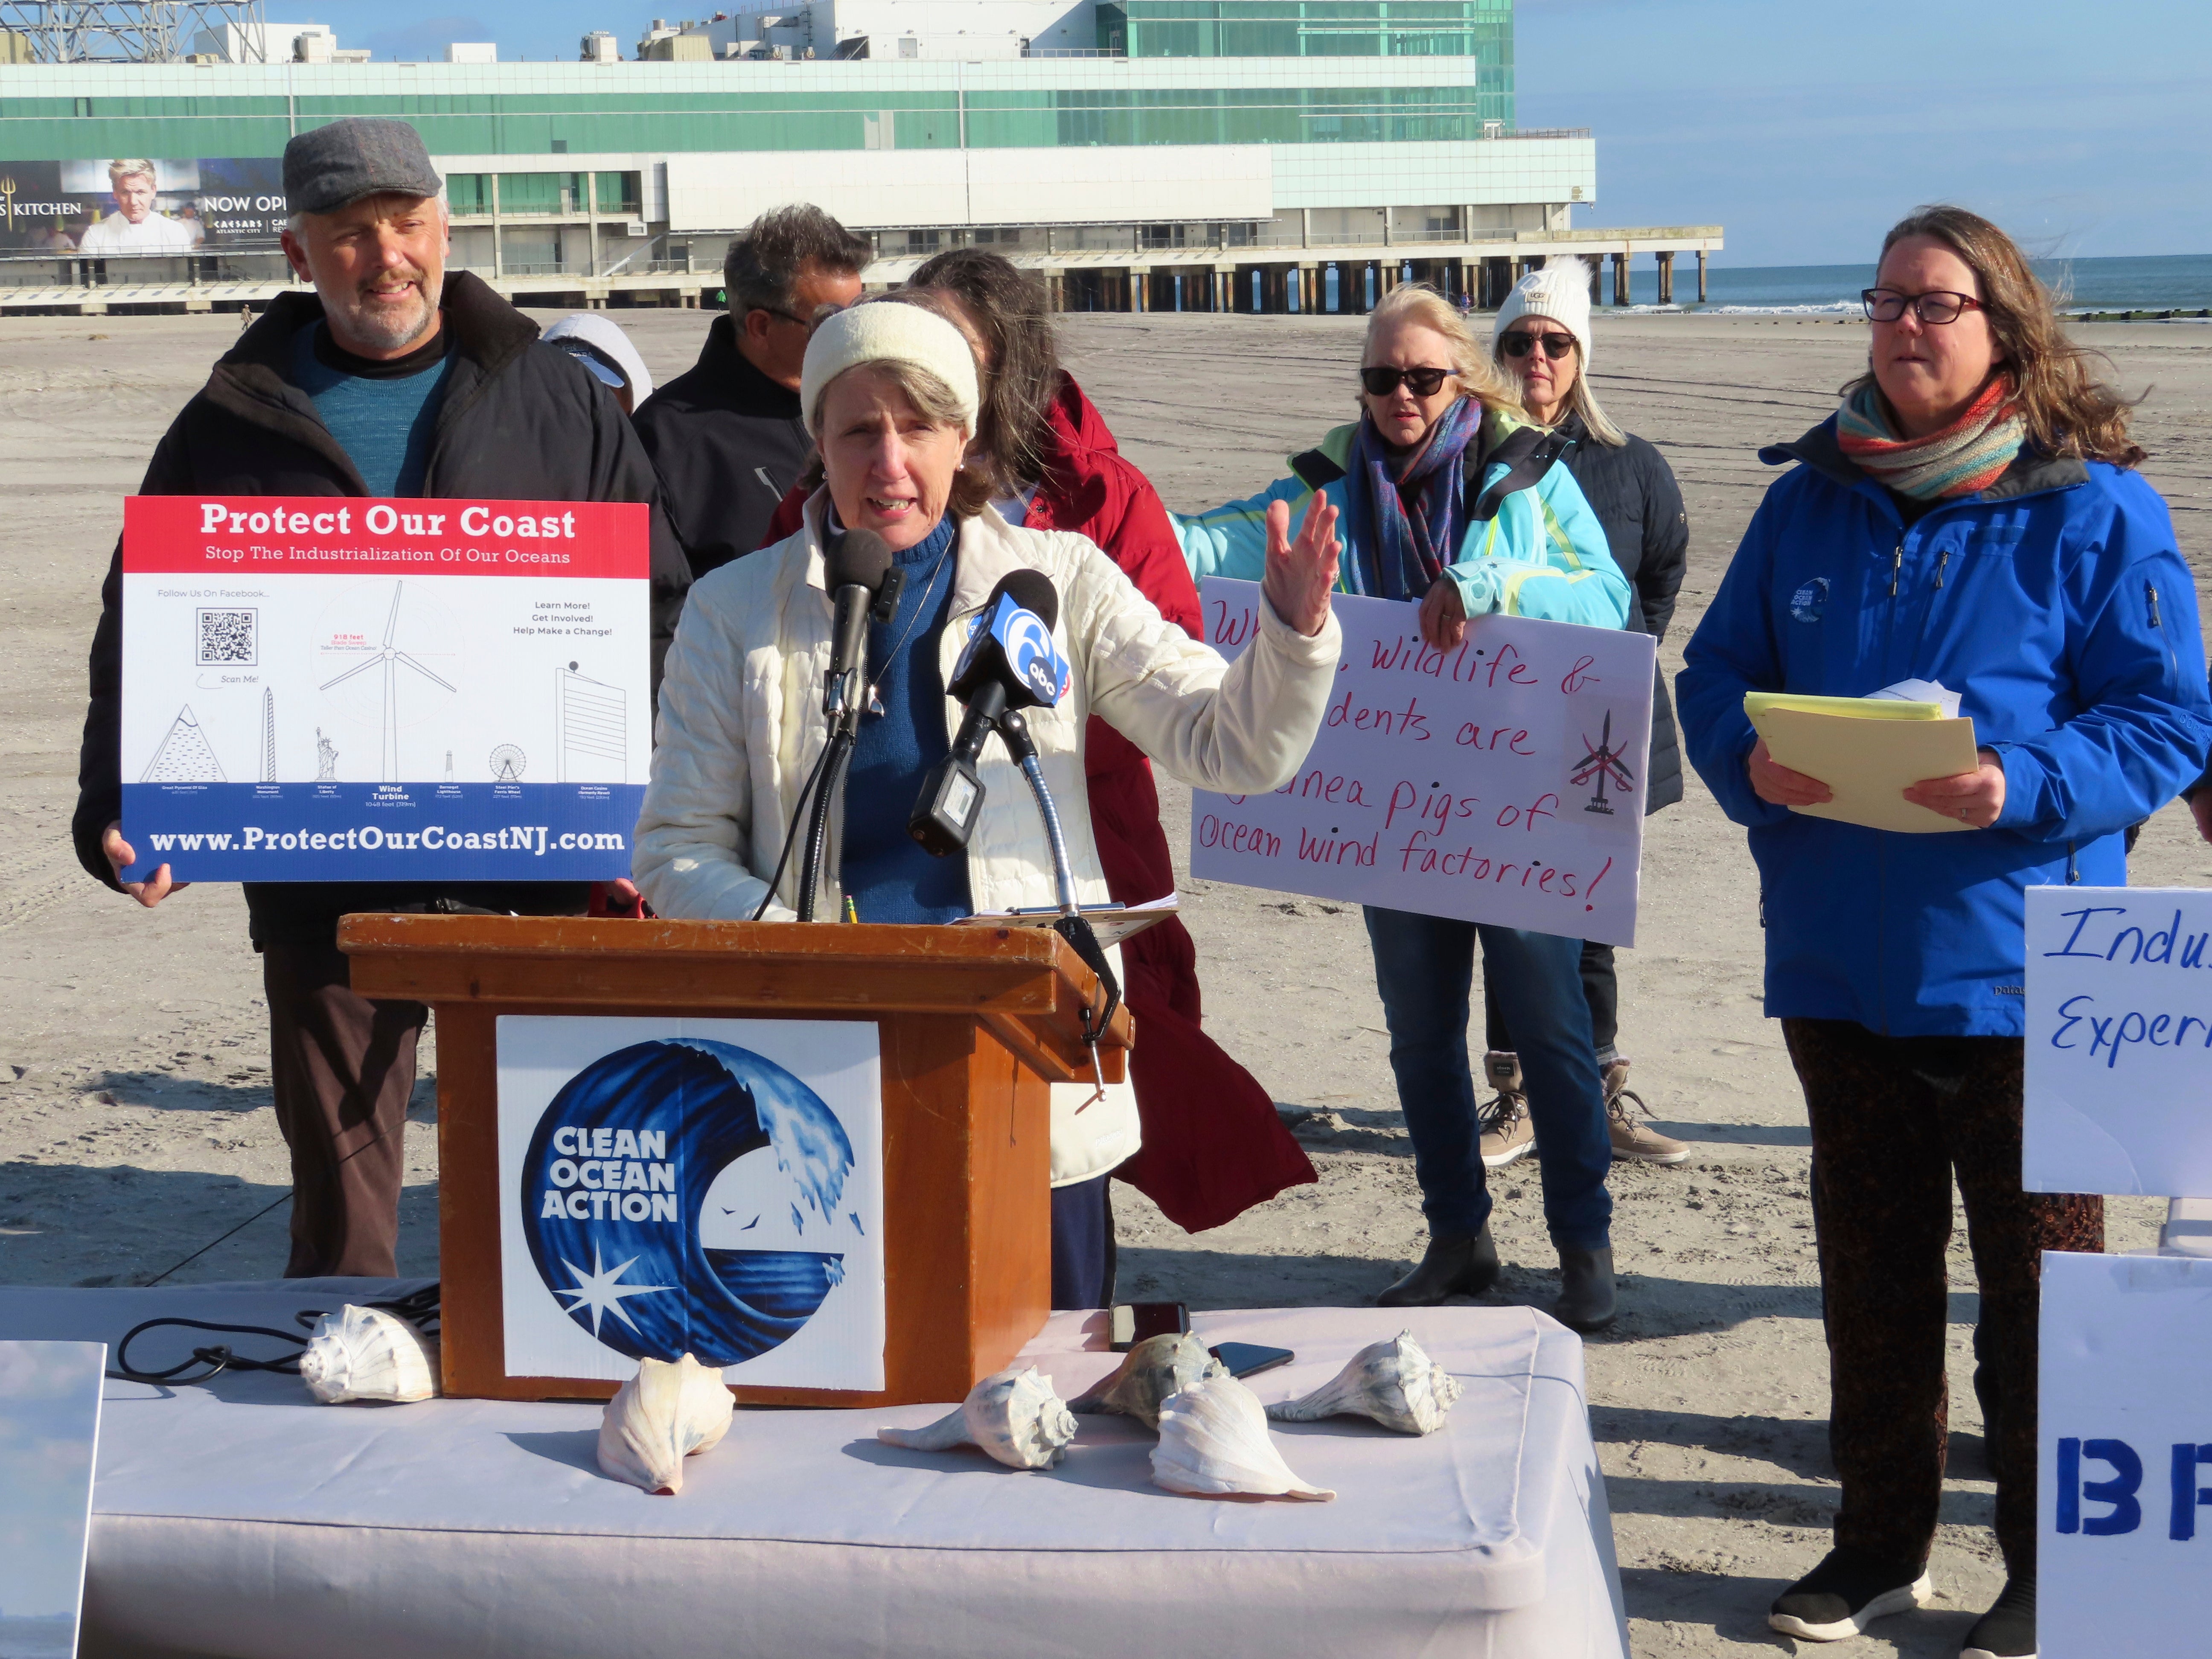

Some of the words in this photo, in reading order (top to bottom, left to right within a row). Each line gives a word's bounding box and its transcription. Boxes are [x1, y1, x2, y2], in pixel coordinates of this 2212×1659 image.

[13, 202, 81, 215] KITCHEN
[205, 197, 251, 212] NOW
[214, 219, 262, 228] CAESARS
[201, 503, 351, 535] Protect
[366, 505, 446, 536] Our
[460, 506, 576, 538] Coast
[206, 546, 244, 563] Stop
[250, 546, 284, 559] The
[289, 546, 434, 562] Industrialization
[440, 548, 462, 561] Of
[466, 548, 500, 562] Our
[505, 549, 570, 564] Oceans
[158, 589, 188, 597] Follow
[190, 589, 202, 597] Us
[204, 589, 217, 597] On
[220, 589, 270, 597] Facebook...
[513, 627, 535, 635] Help
[573, 628, 612, 637] Change!
[221, 675, 241, 683] Scan
[243, 675, 259, 683] Me!
[1029, 662, 1056, 696] abc
[1560, 655, 1601, 695] &
[1455, 722, 1536, 756] are
[1496, 793, 1560, 832] of
[150, 826, 626, 856] www.ProtectOurCoastNJ.com
[1399, 830, 1612, 912] factories!
[2043, 907, 2212, 969] Indu
[553, 1126, 666, 1160] CLEAN
[549, 1158, 676, 1192] OCEAN
[540, 1190, 678, 1223] ACTION
